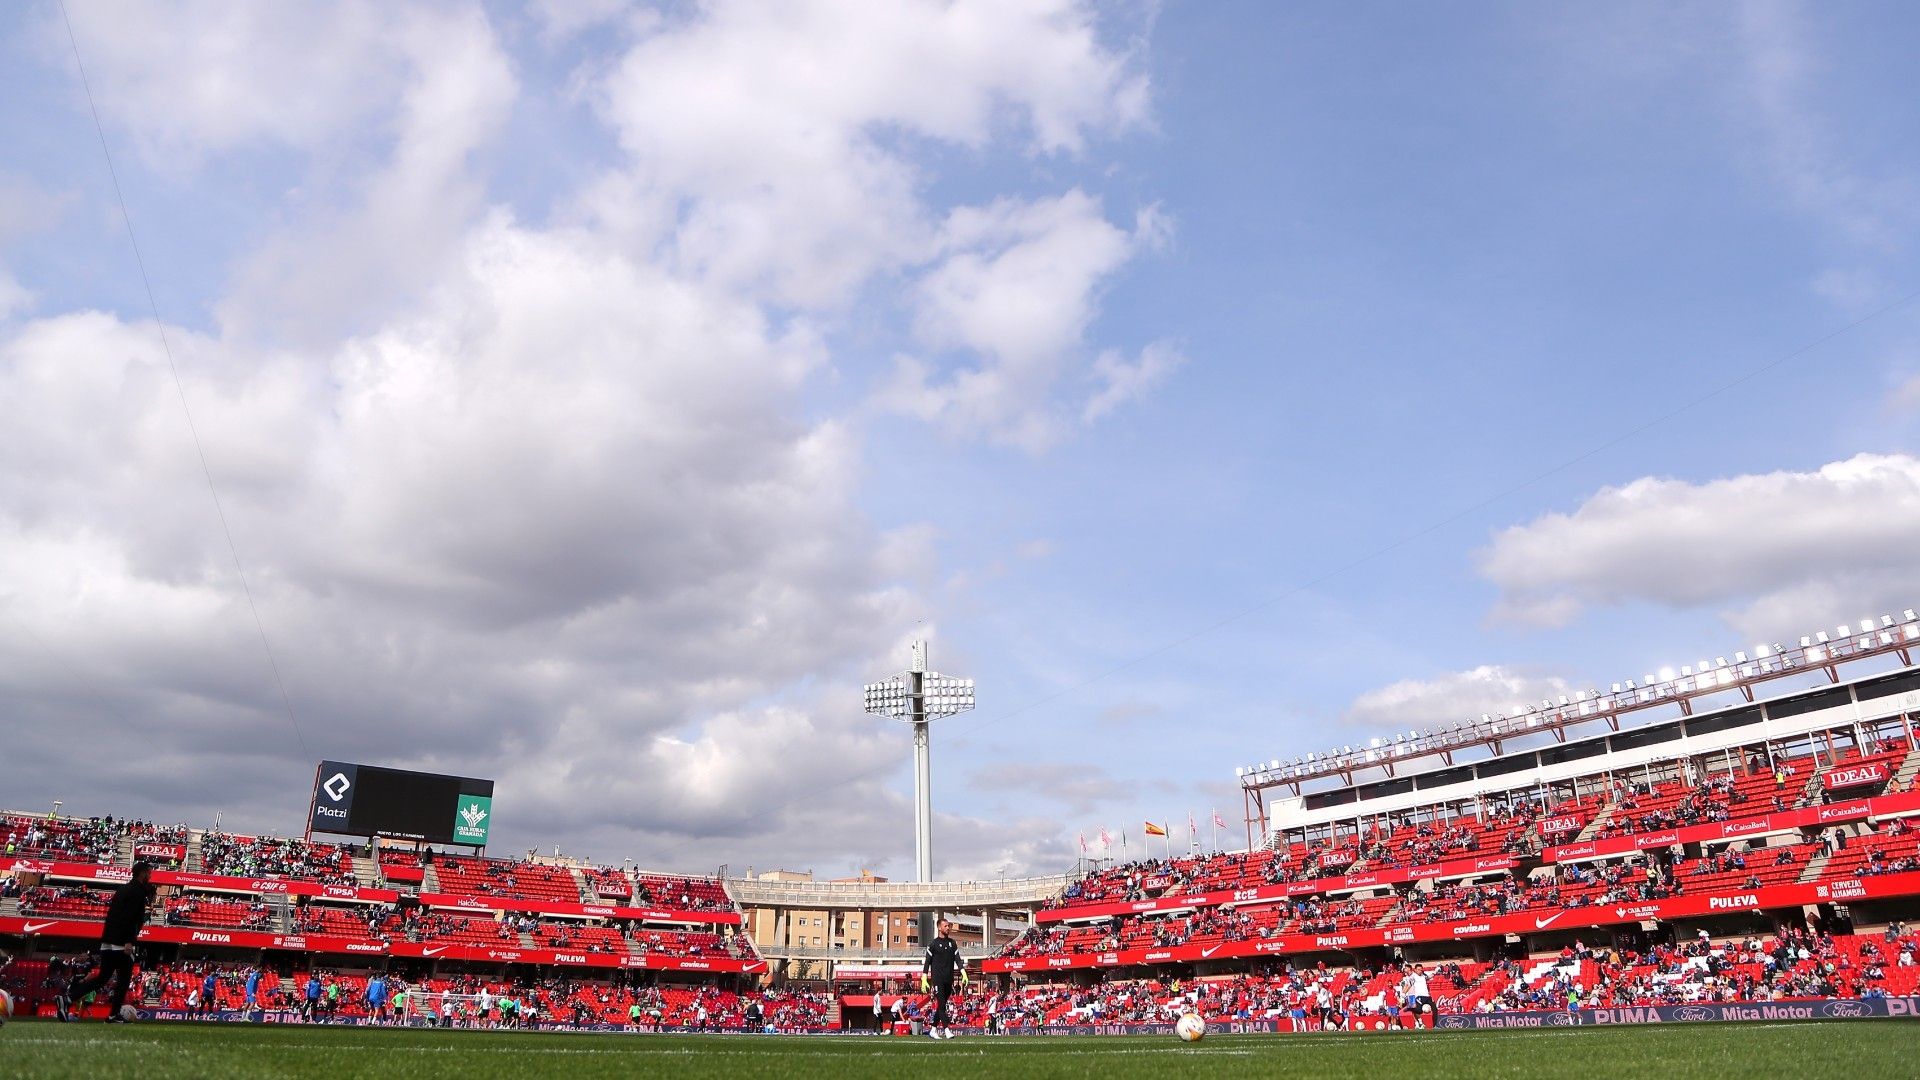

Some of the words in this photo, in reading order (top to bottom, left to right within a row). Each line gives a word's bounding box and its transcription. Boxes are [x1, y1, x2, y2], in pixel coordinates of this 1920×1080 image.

[1830, 766, 1882, 785] IDEAL
[317, 806, 347, 818] Platzi
[1831, 805, 1869, 816] CaixaBank
[1542, 817, 1580, 831] IDEAL
[1733, 821, 1767, 832] CaixaBank
[1645, 836, 1677, 845] CaixaBank
[141, 845, 178, 857] IDEAL
[1565, 846, 1594, 856] CaixaBank
[1323, 853, 1352, 864] IDEAL
[260, 881, 279, 891] CSIF
[1145, 878, 1171, 889] IDEAL
[1831, 880, 1863, 890] CERVEZAS
[328, 887, 354, 897] TIPSA
[598, 885, 628, 895] IDEAL
[1831, 888, 1867, 899] ALHAMBRA
[1709, 894, 1759, 909] PULEVA
[191, 932, 231, 943] PULEVA
[1316, 936, 1348, 946] PULEVA
[555, 953, 586, 963] PULEVA
[1680, 1009, 1706, 1021] Ford
[1722, 1006, 1760, 1021] Mica
[1762, 1004, 1813, 1020] Motor
[1834, 1002, 1863, 1018] Ford
[155, 1012, 183, 1020] Mica
[1475, 1016, 1504, 1028] Mica
[1506, 1015, 1542, 1027] Motor
[1594, 1008, 1662, 1024] PUMA
[1445, 1017, 1464, 1028] Ford
[1095, 1026, 1127, 1035] PUMA
